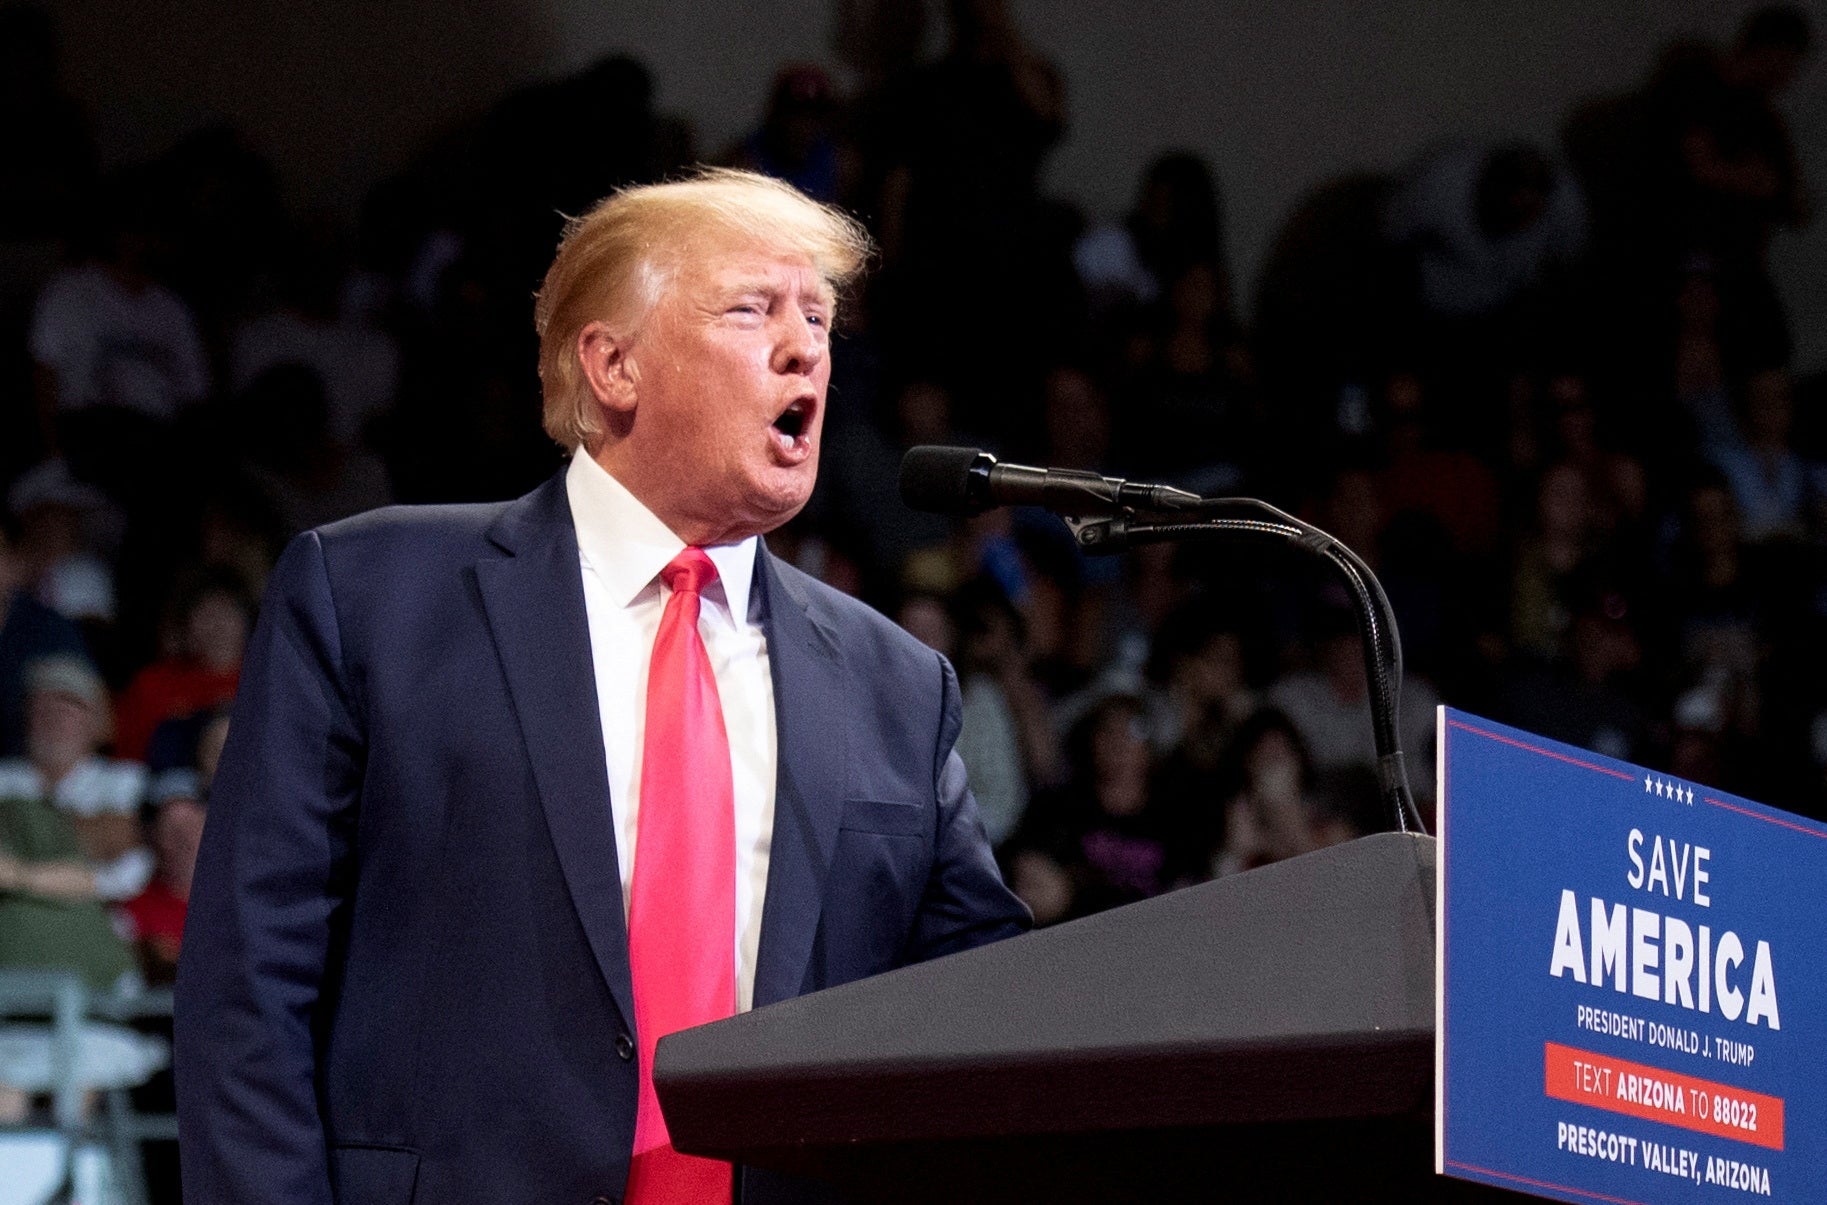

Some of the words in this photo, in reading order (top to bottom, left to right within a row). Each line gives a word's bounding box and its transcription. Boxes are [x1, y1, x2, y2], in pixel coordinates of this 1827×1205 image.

[1627, 828, 1711, 908] SAVE
[1549, 888, 1781, 1031] AMERICA
[1577, 1004, 1645, 1042] PRESIDENT
[1649, 1023, 1699, 1055] DONALD
[1702, 1036, 1712, 1058] J.
[1715, 1037, 1755, 1067] TRUMP
[1573, 1060, 1611, 1096] TEXT
[1616, 1072, 1685, 1114] ARIZONA
[1689, 1089, 1709, 1120] TO
[1713, 1095, 1757, 1131] 88022
[1558, 1121, 1637, 1166] PRESCOTT
[1641, 1139, 1701, 1187] VALLEY,
[1705, 1156, 1771, 1196] ARIZONA
